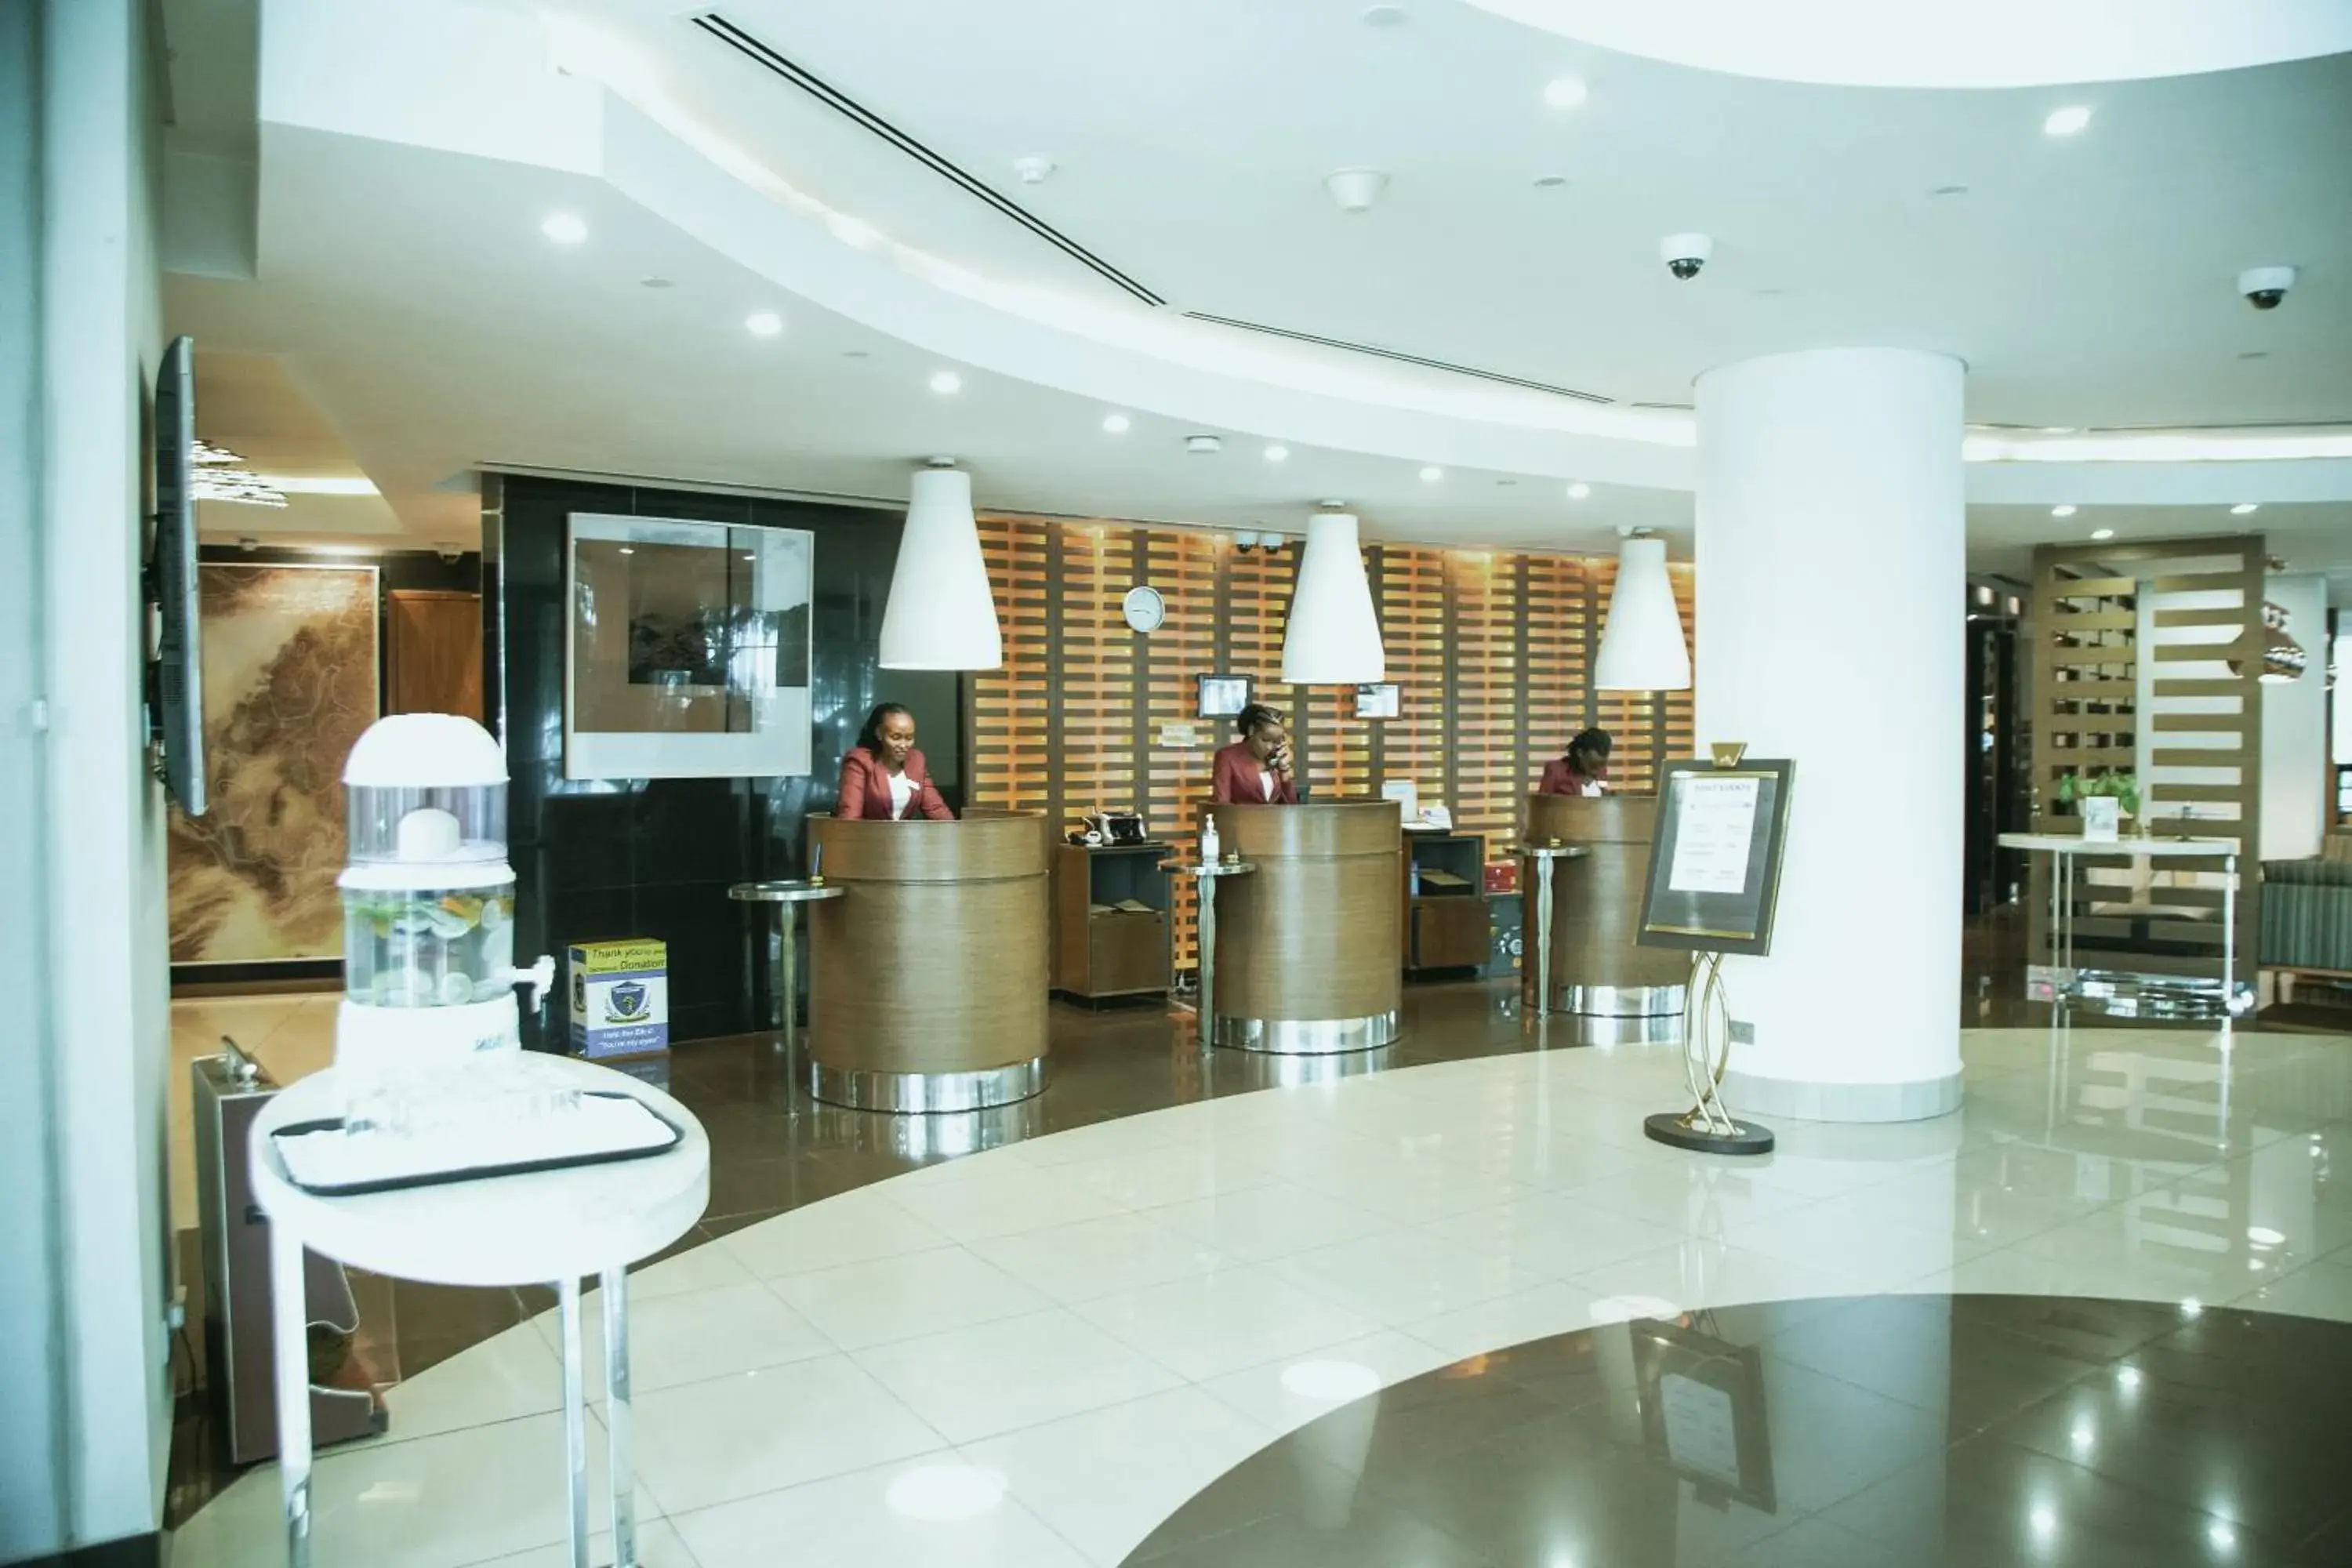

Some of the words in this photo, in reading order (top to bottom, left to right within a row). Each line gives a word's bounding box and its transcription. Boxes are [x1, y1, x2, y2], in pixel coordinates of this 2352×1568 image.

[593, 948, 622, 960] Thank
[625, 947, 643, 958] you
[621, 959, 665, 970] Donation
